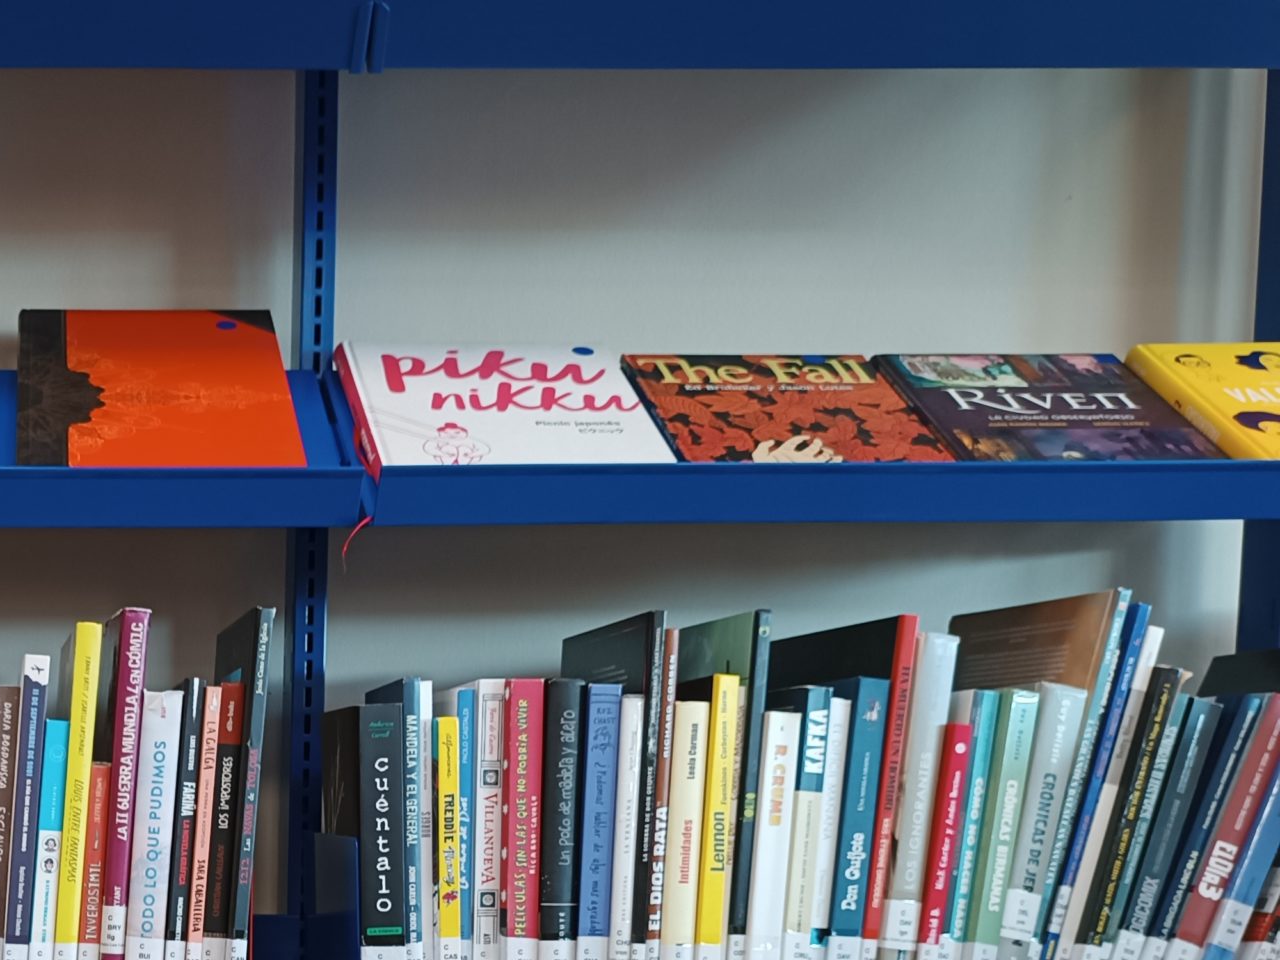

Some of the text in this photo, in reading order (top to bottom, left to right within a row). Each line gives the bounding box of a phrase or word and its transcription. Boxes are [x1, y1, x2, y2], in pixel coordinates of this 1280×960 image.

[381, 350, 607, 393] piku
[637, 358, 876, 384] The Fall
[432, 382, 641, 412] nikku
[1223, 386, 1280, 404] VAL
[126, 622, 144, 668] CÓMIC
[122, 686, 138, 752] MUNDIAL
[206, 721, 216, 735] LA
[560, 710, 576, 743] acero
[663, 705, 672, 758] RICHARD
[202, 737, 215, 771] GALGA
[405, 714, 417, 769] MANDELA
[560, 747, 577, 755] y
[688, 723, 699, 756] Corman
[804, 709, 829, 775] KAFKA
[116, 753, 134, 811] GUERRA
[149, 741, 166, 819] PUDIMOS
[218, 757, 233, 830] LOS IMPOSTORES
[405, 785, 418, 797] EL
[517, 779, 527, 793] NO
[556, 757, 574, 799] madera
[770, 764, 786, 826] CRUMB
[180, 781, 196, 817] FARIÑA
[517, 799, 527, 819] QUE
[558, 801, 571, 815] de
[1032, 772, 1057, 847] CRÓNICAS
[406, 798, 418, 848] GENERAL
[444, 794, 455, 844] FREDDIE
[516, 825, 527, 845] LAS
[904, 752, 933, 891] LOS IGNORANTES
[967, 824, 977, 847] NO
[146, 826, 162, 863] QUE
[482, 794, 498, 886] VILLANUEVA
[516, 850, 526, 867] SIN
[558, 850, 570, 866] Un
[678, 819, 693, 885] Intimidades
[710, 811, 725, 872] Lennon
[1027, 849, 1042, 867] DE
[144, 866, 157, 888] LO
[648, 806, 667, 931] EL DIOS RATA
[988, 845, 1009, 913] BIRMANAS
[840, 884, 859, 911] Don
